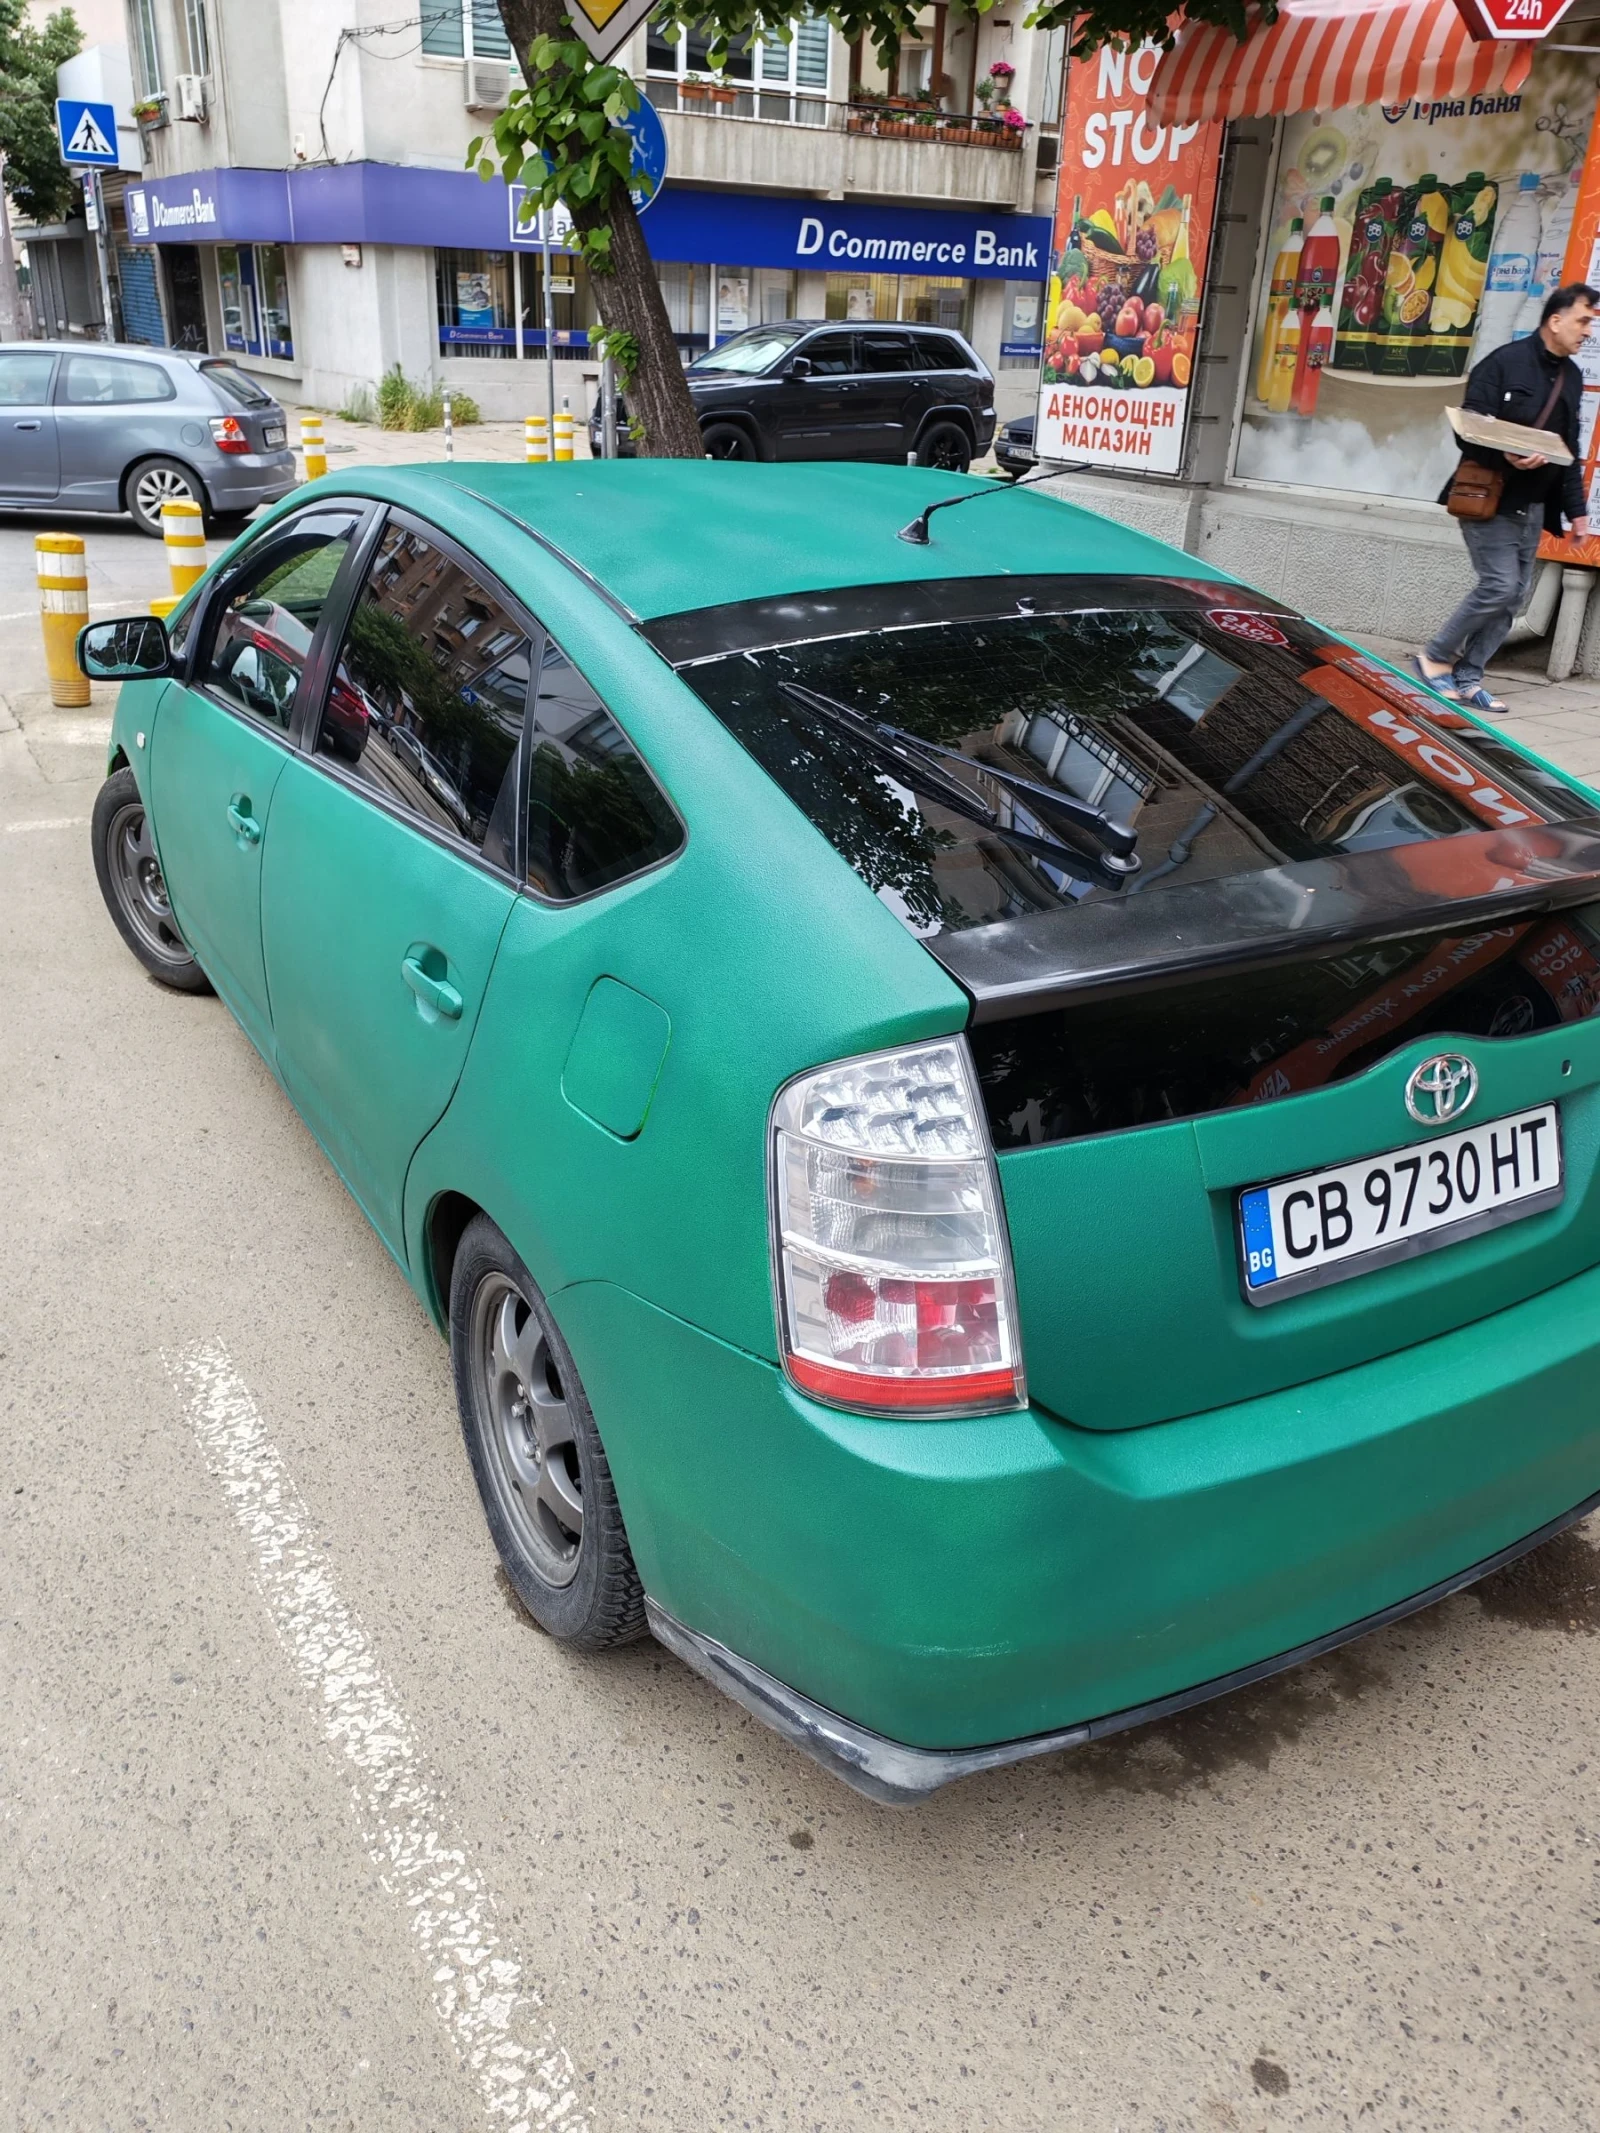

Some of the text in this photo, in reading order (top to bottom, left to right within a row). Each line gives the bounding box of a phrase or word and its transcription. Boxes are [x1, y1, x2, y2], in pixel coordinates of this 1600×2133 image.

[1504, 0, 1543, 20] 24h
[1082, 110, 1199, 169] STOP
[160, 202, 194, 227] Commerce
[193, 188, 216, 223] Bank
[796, 217, 1039, 268] D Commerce Bank
[1047, 393, 1175, 430] ДЕНОНОЩЕН
[1062, 423, 1152, 456] МАГАЗИН
[1250, 1117, 1547, 1273] BG CB 9730 HT
